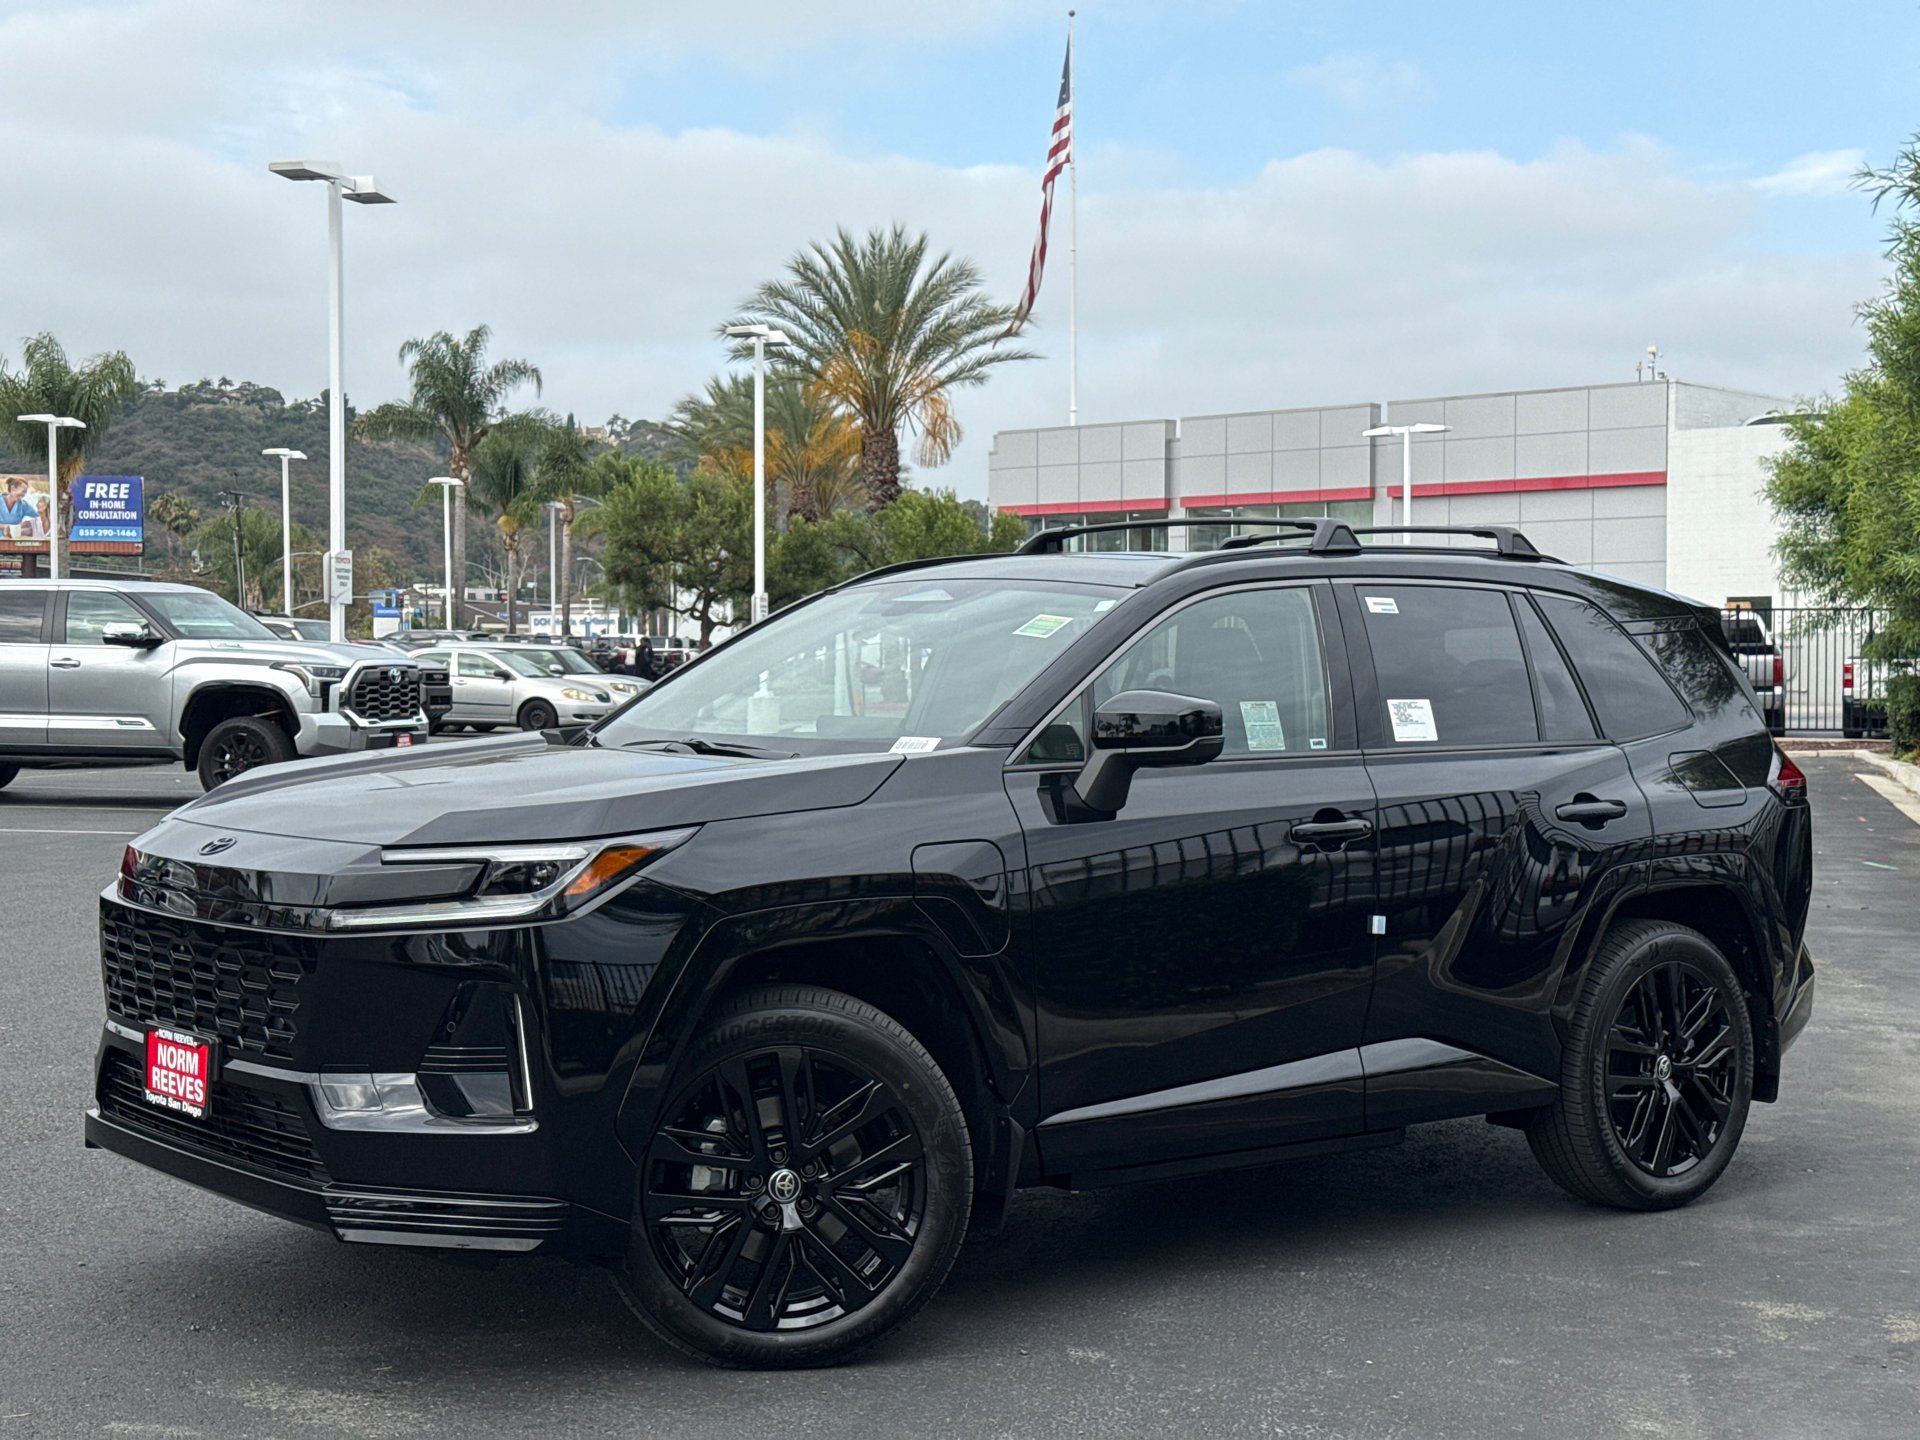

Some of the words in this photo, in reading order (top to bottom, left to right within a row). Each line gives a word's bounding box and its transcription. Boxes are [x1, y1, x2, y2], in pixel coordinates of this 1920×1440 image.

[84, 482, 131, 499] FREE
[89, 500, 126, 510] IN-HOME
[78, 510, 138, 520] CONSULTATION
[78, 528, 138, 538] 858-290-1466
[158, 1028, 173, 1040] NORM
[174, 1033, 194, 1046] REEVES
[692, 1015, 848, 1057] RIDGESTONE
[157, 1043, 199, 1075] NORM
[152, 1065, 204, 1103] REEVES
[145, 1090, 167, 1105] Toyota
[168, 1097, 181, 1110] San
[182, 1101, 202, 1117] Diego
